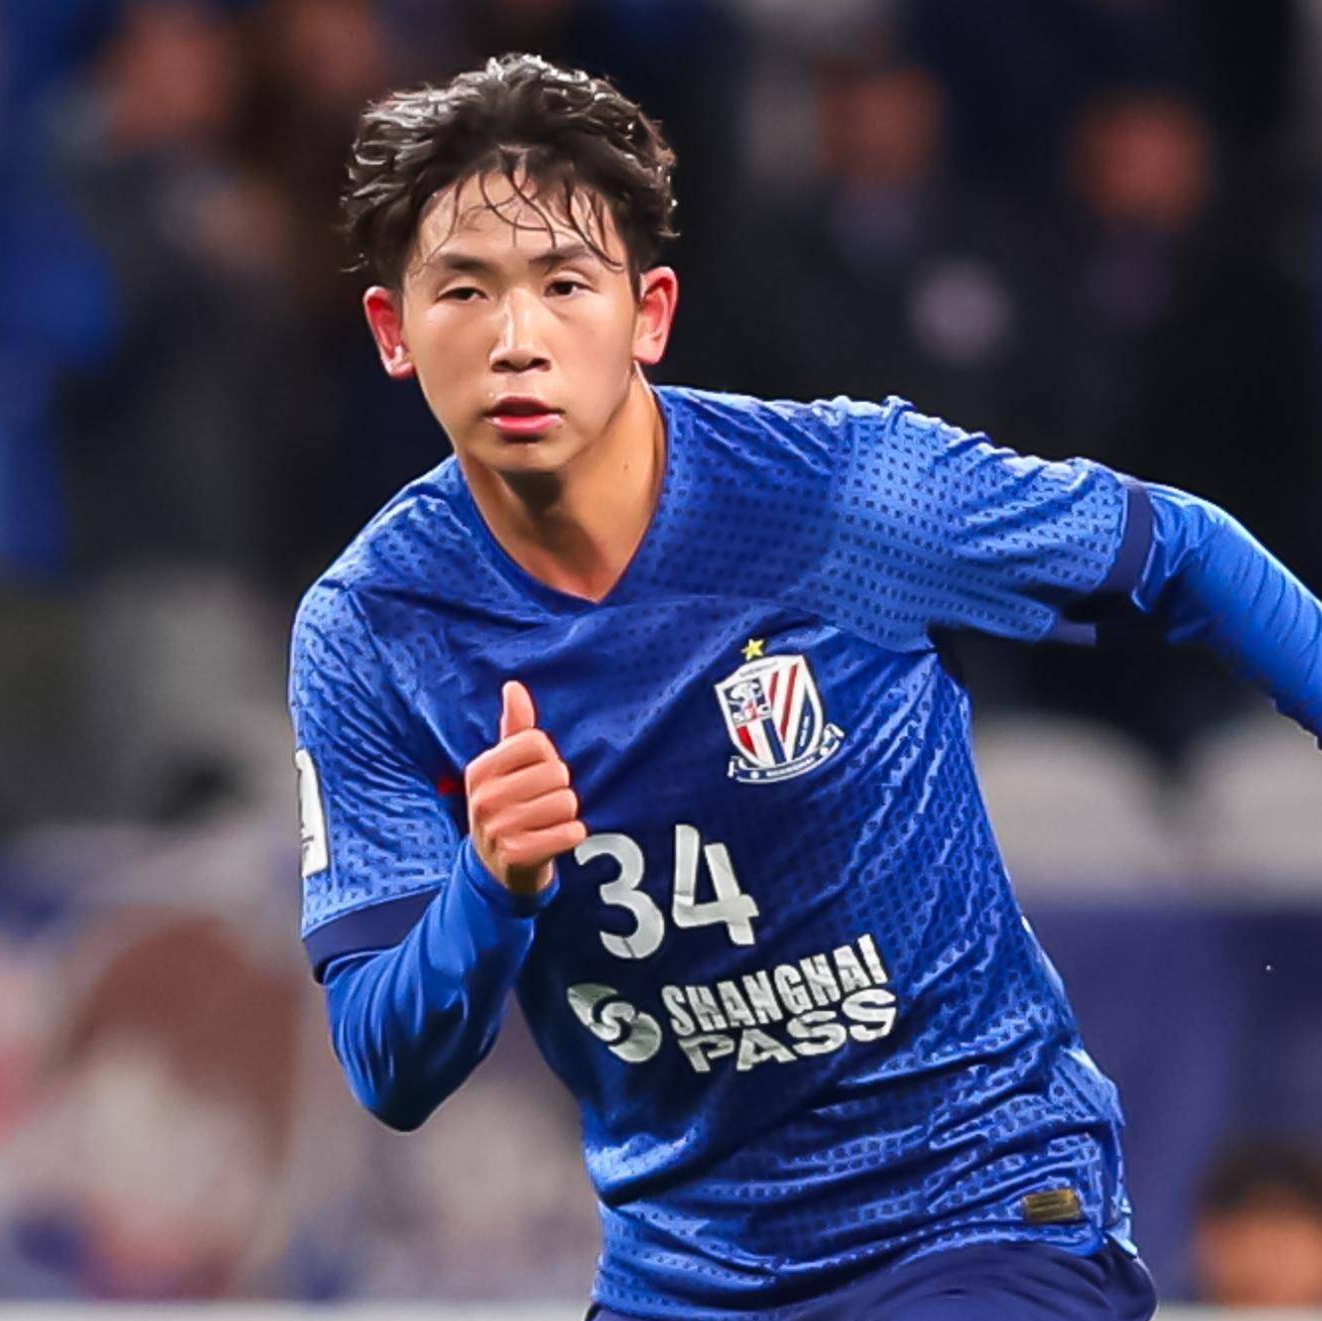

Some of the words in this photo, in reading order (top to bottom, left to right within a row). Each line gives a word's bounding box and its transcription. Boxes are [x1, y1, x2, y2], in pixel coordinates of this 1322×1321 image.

[574, 824, 759, 959] 34
[661, 933, 888, 1036] SHANGHAI
[678, 989, 896, 1073] PASS
